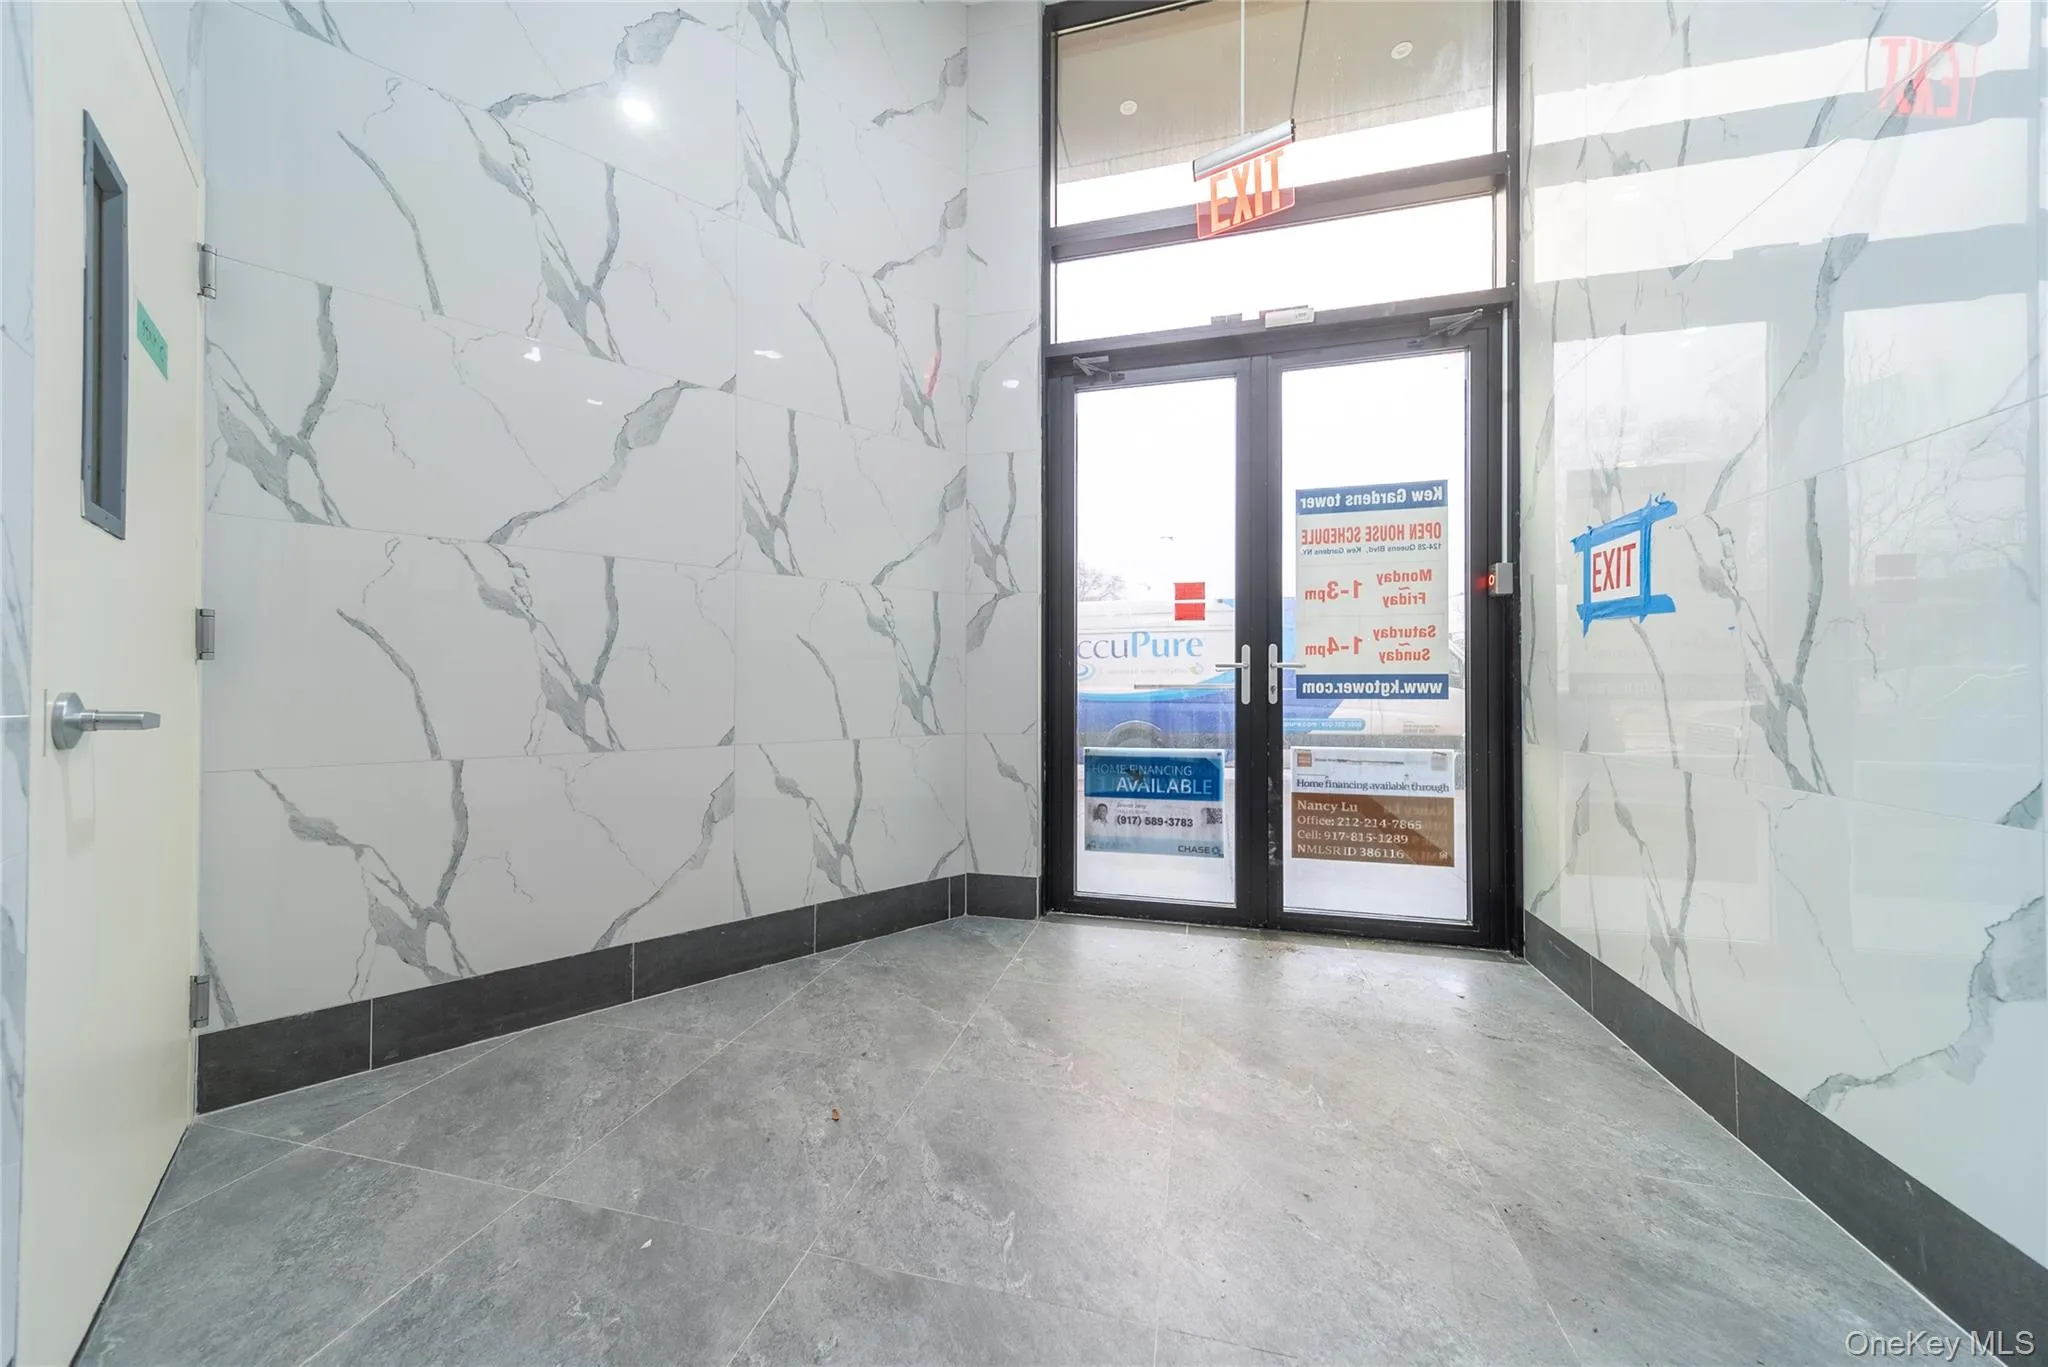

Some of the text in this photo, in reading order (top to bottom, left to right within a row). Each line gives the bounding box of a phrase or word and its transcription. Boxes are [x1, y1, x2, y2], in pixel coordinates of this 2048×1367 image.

[1210, 149, 1284, 233] EXIT
[1592, 543, 1637, 593] EXIT
[1093, 763, 1127, 775] HOME
[1116, 777, 1213, 795] AVAILABLE
[1297, 778, 1450, 793] Home financing available through
[1297, 799, 1358, 814] Nancy Lu
[1116, 814, 1194, 828] (917) 589-3783
[1297, 815, 1422, 831] Office: 212-214-7865
[1297, 829, 1409, 845] Cell: 917-815-1289
[1178, 845, 1211, 855] CHASE
[1297, 844, 1405, 860] NMLSR ID 386116
